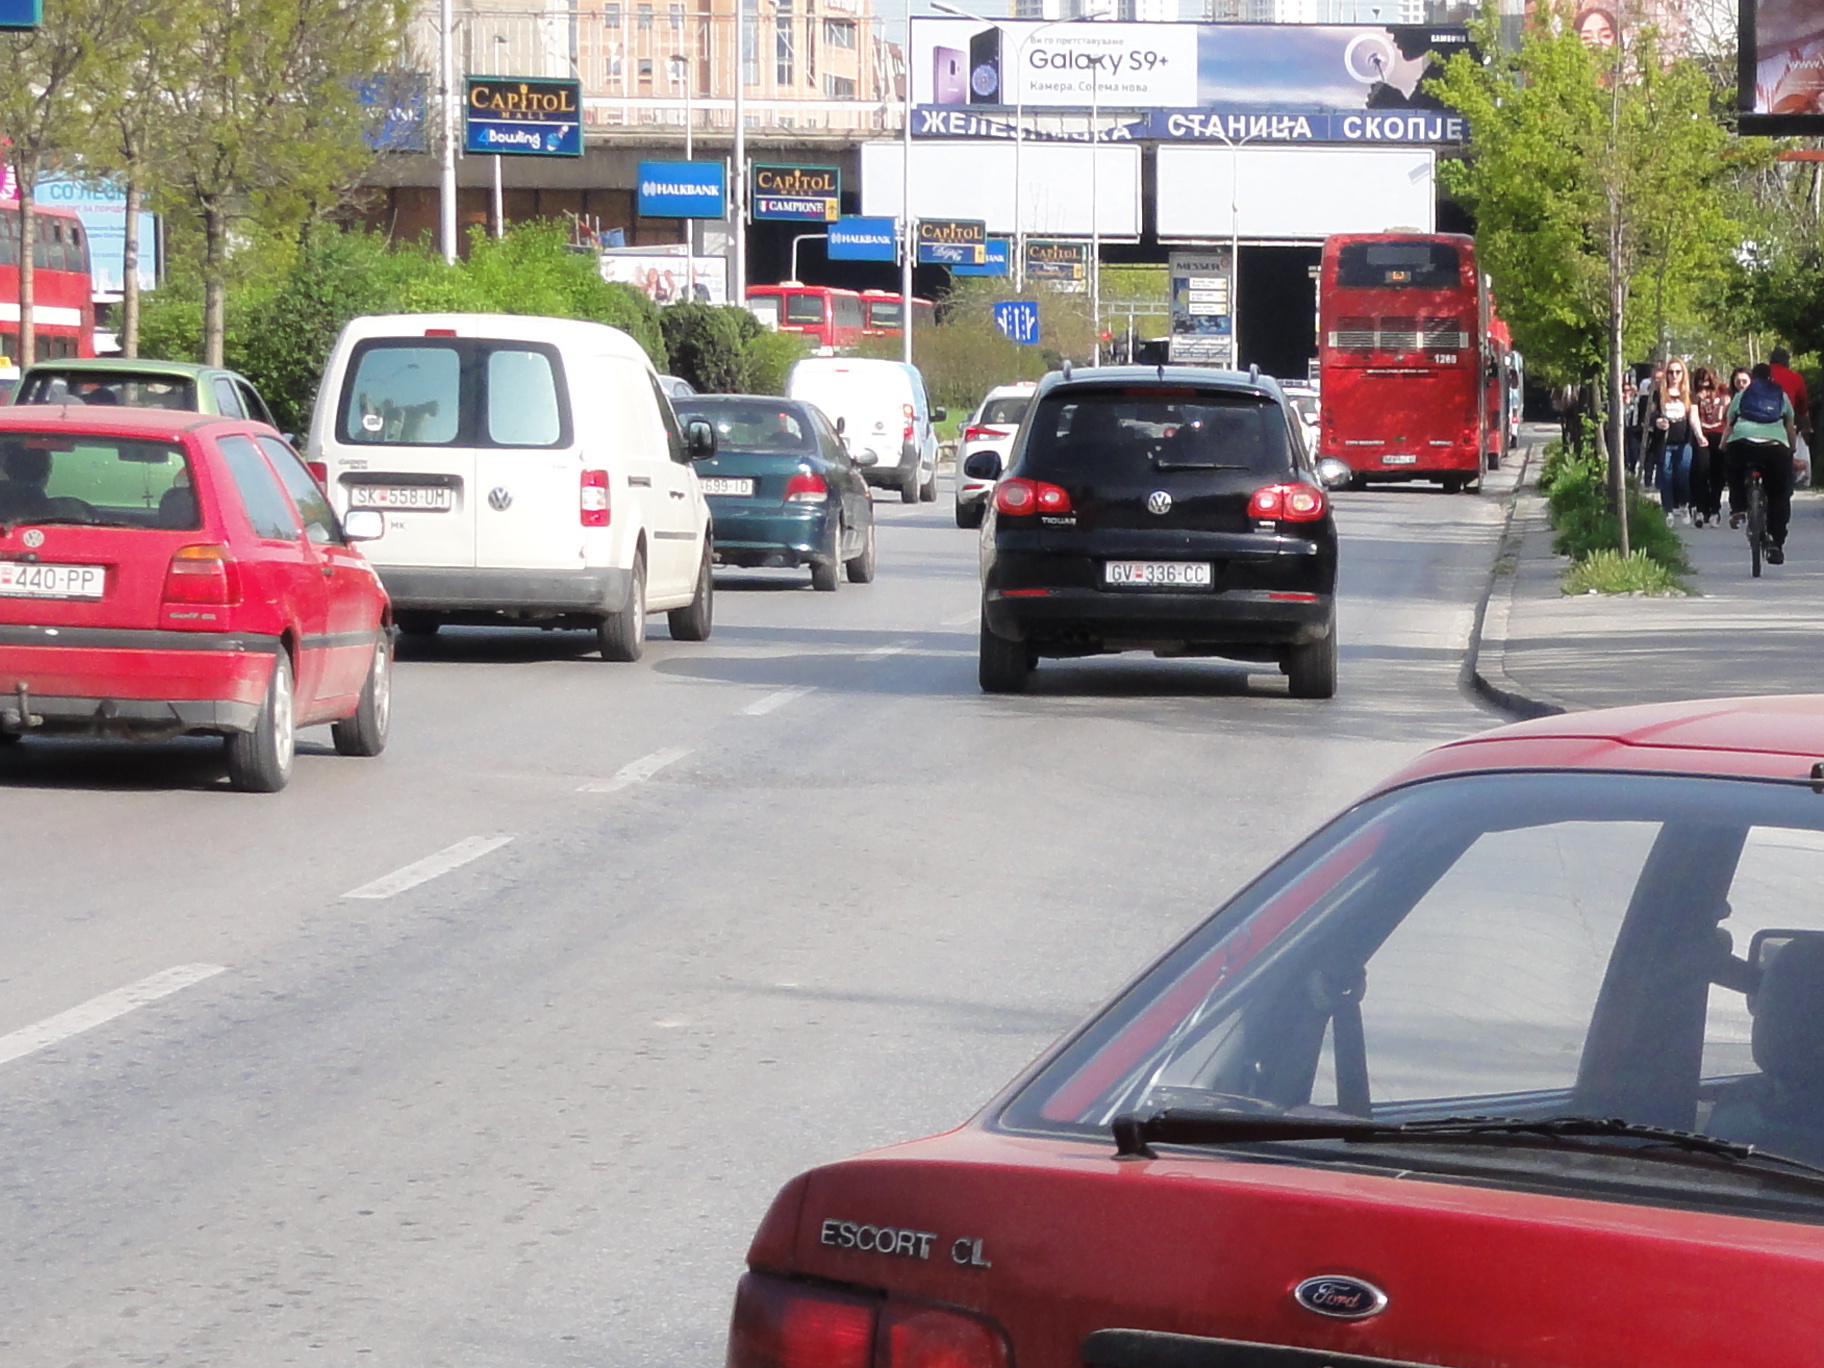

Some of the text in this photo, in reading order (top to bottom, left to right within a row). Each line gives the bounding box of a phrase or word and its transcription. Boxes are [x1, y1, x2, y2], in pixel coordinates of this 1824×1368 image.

[1129, 50, 1169, 71] S9+
[1078, 81, 1119, 92] Соема
[470, 83, 576, 112] CAPITOL
[1168, 114, 1313, 141] СТАНИЦА
[1343, 116, 1463, 141] СКОПЈЕ
[657, 181, 719, 196] HALKBANK
[758, 169, 836, 191] CAPITOL
[842, 234, 891, 245] HALKBANK
[921, 222, 983, 241] CAPITOL
[358, 488, 377, 504] SK
[15, 568, 95, 591] 440-PP
[1112, 564, 1204, 583] GV 336-CC
[821, 1217, 992, 1268] ESCORT CL
[1312, 1282, 1362, 1308] Ford
